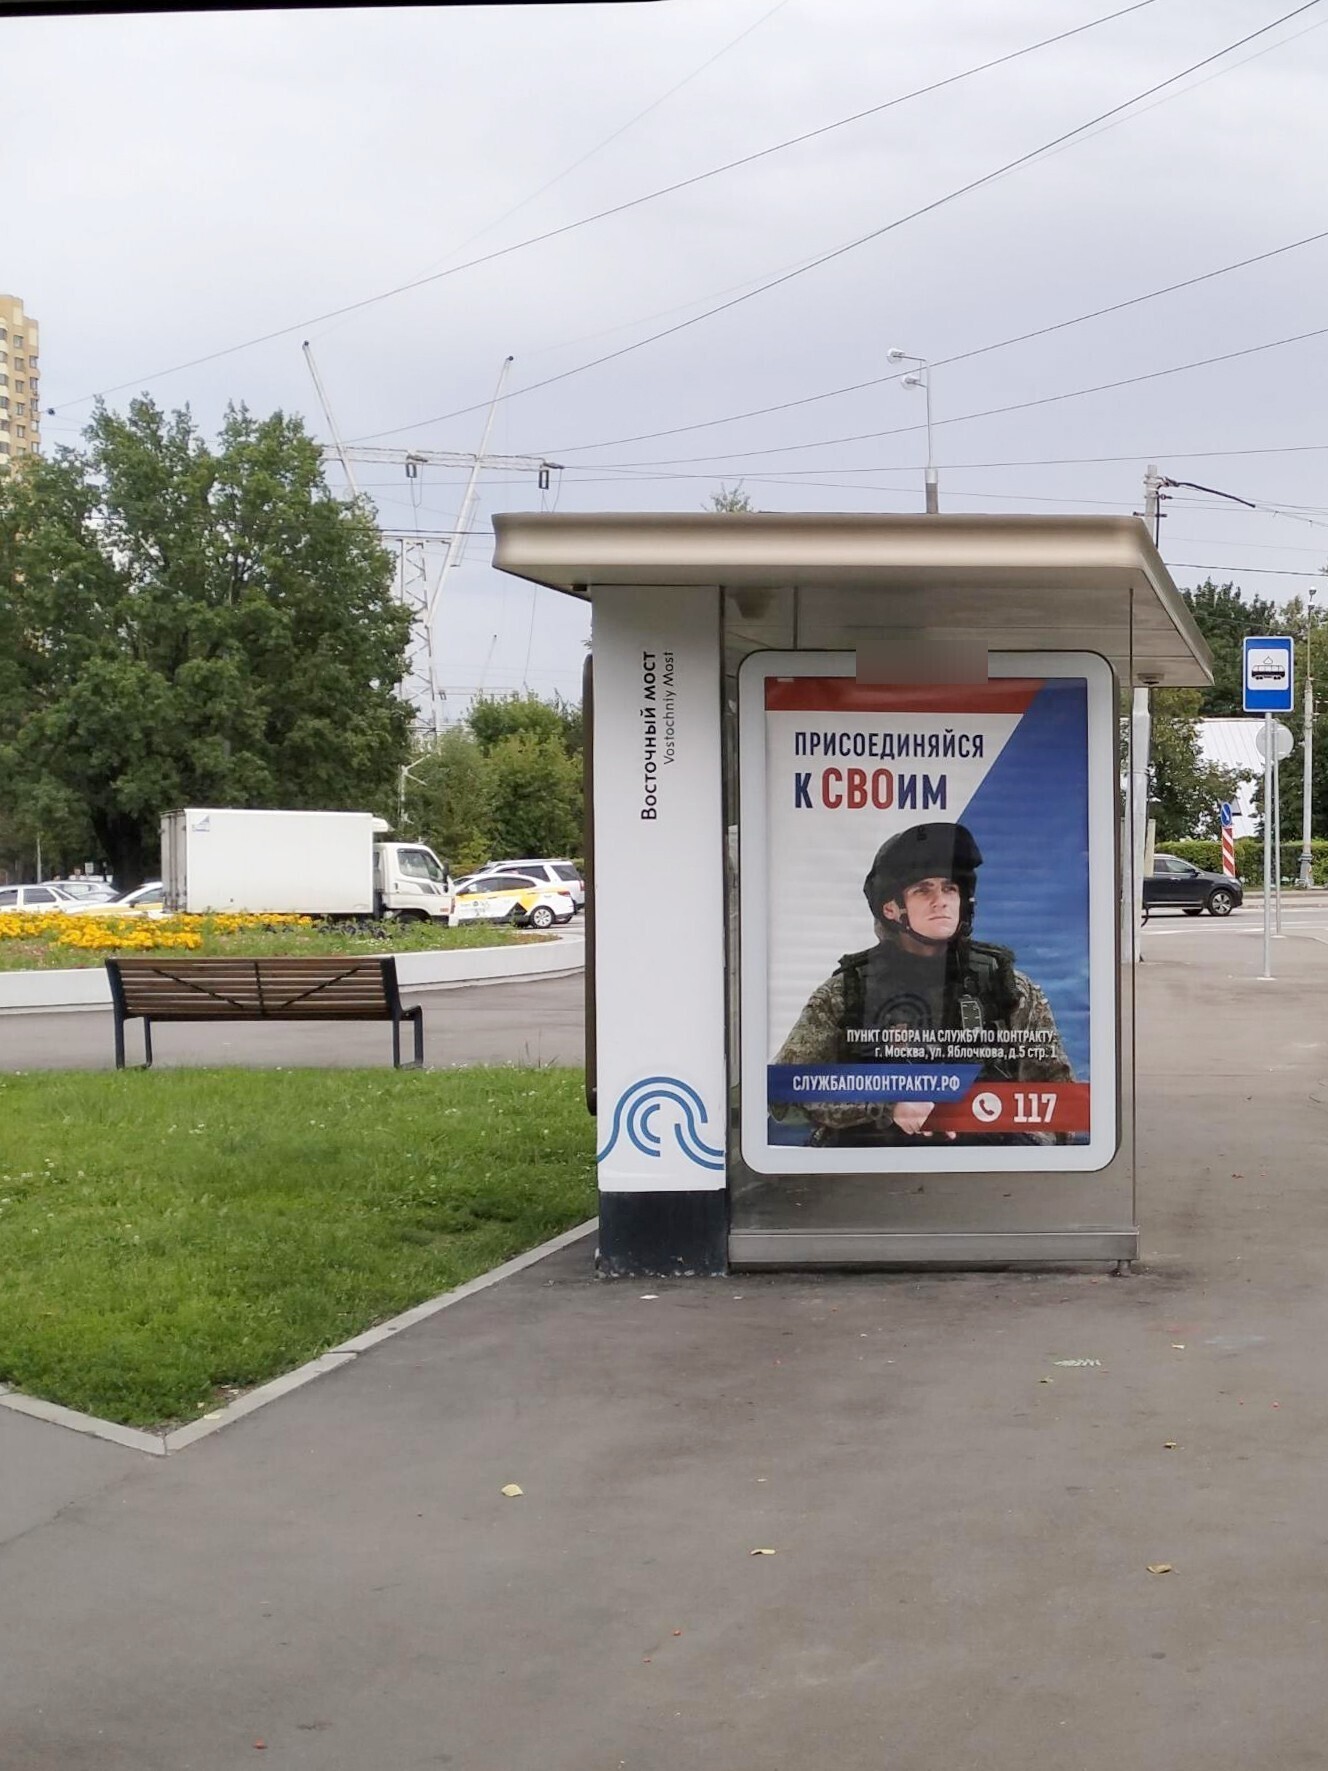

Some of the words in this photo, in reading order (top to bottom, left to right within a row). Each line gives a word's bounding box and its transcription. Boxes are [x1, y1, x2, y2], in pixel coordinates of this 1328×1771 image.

[643, 651, 656, 701] мост
[662, 651, 674, 687] Most
[662, 690, 677, 765] Vostochniy
[794, 729, 984, 760] ПРИСОЕДИНЯЙСЯ
[640, 708, 657, 820] Восточный
[794, 772, 813, 809] К
[822, 767, 948, 810] СВОИМ
[846, 1029, 880, 1043] ПУНКТ
[881, 1029, 920, 1043] ОТБОРА
[922, 1029, 936, 1043] НА
[937, 1029, 980, 1044] СЛУЖБУ
[980, 1029, 995, 1044] ПО
[874, 1046, 883, 1058] г.
[885, 1045, 929, 1060] Москва,
[930, 1046, 945, 1061] ул.
[947, 1045, 1008, 1060] Яблочкова,
[1027, 1046, 1049, 1061] стр.
[1050, 1045, 1057, 1058] 1
[793, 1074, 961, 1092] СЛУЖБАПОКОНТРАКТУ.РФ
[1013, 1092, 1057, 1123] 117
